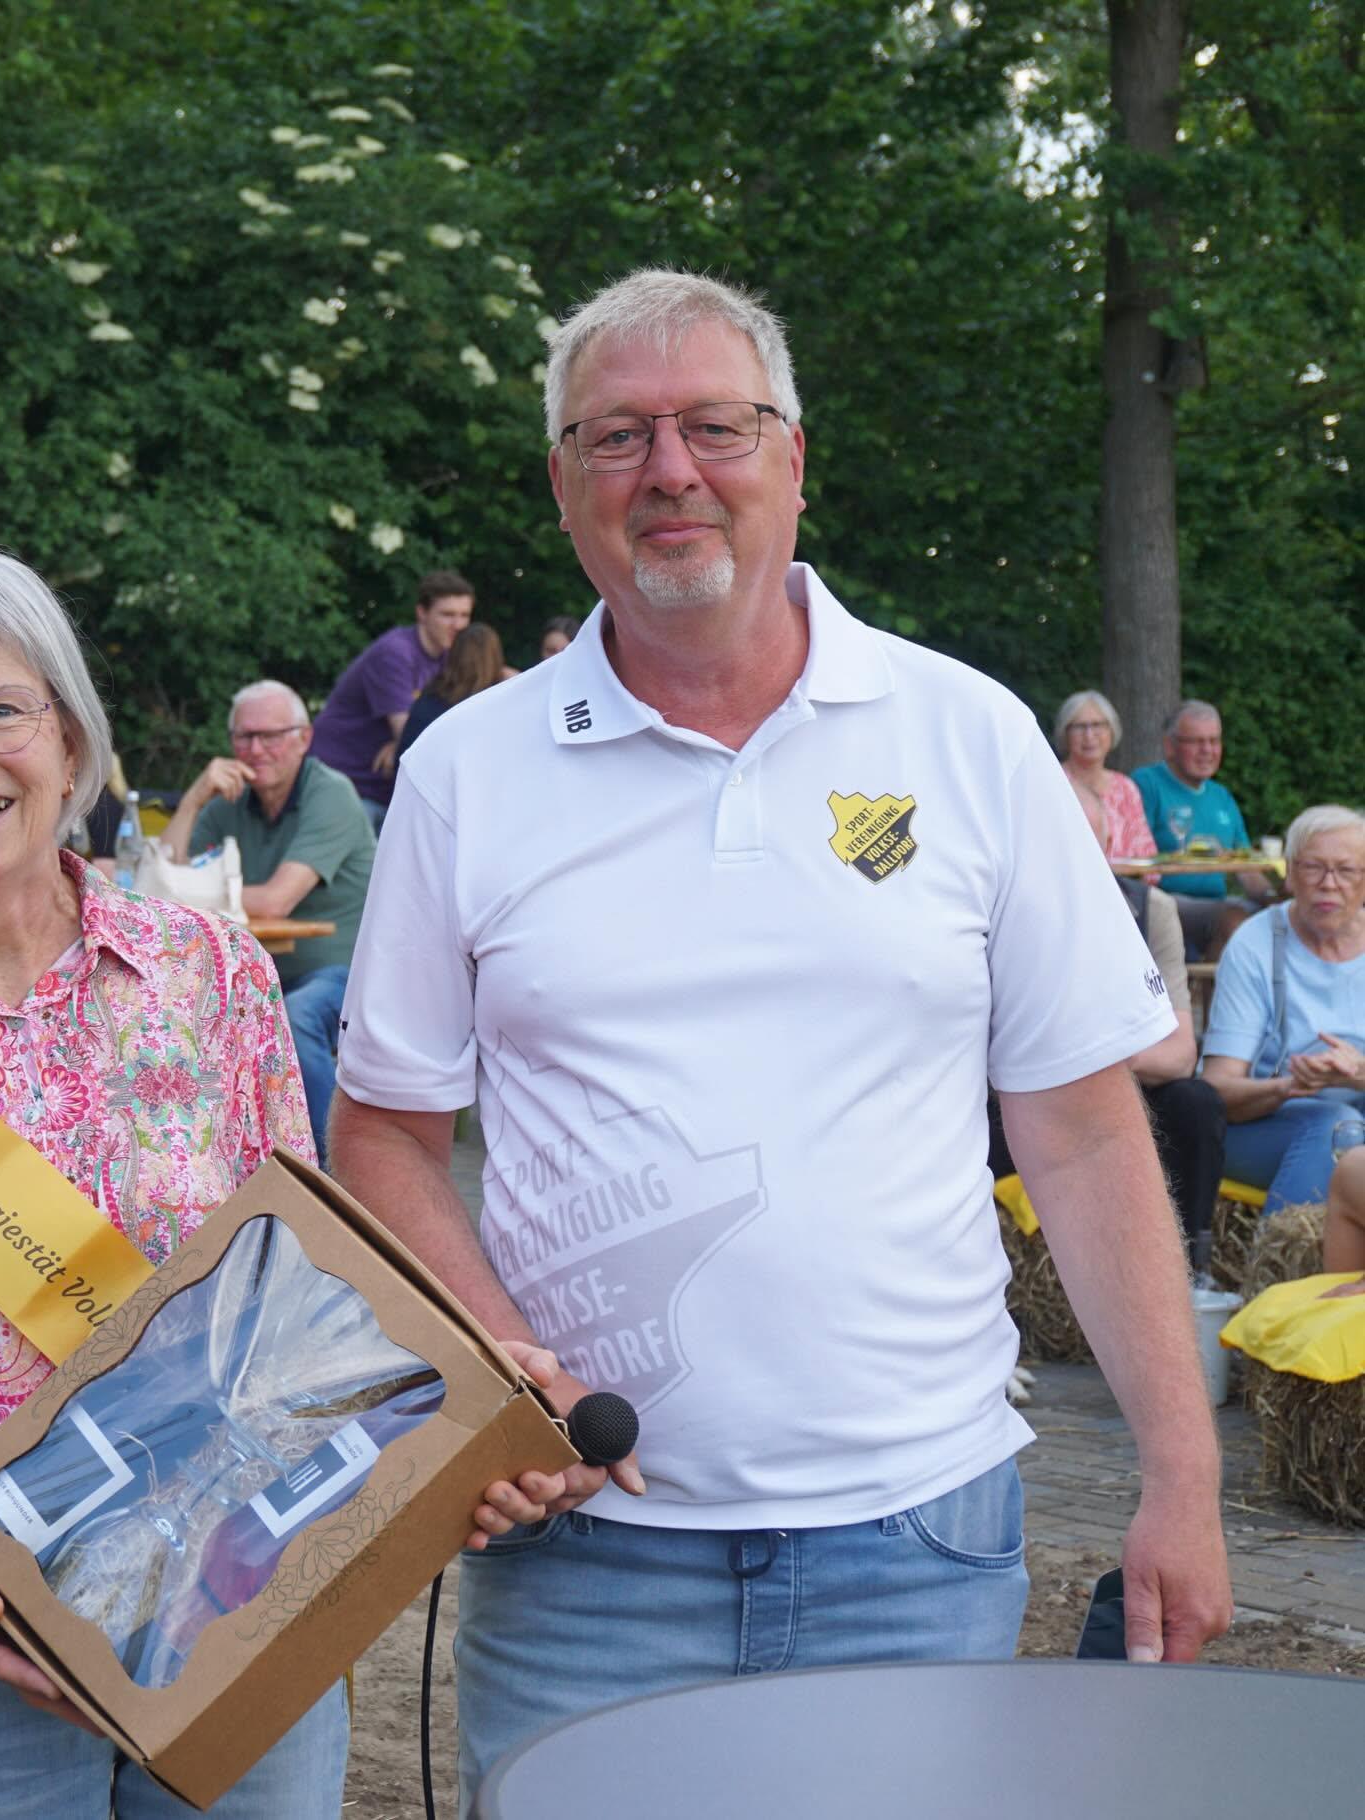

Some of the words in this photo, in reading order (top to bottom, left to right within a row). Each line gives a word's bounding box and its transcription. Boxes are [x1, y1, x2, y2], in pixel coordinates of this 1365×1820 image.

[563, 699, 592, 733] MB
[845, 807, 875, 834] SPORT-
[845, 804, 900, 853] VEREINIGUNG
[863, 830, 900, 862] VOLKSE-
[873, 835, 915, 876] DALLDORF
[523, 1267, 627, 1342] OLKSE-
